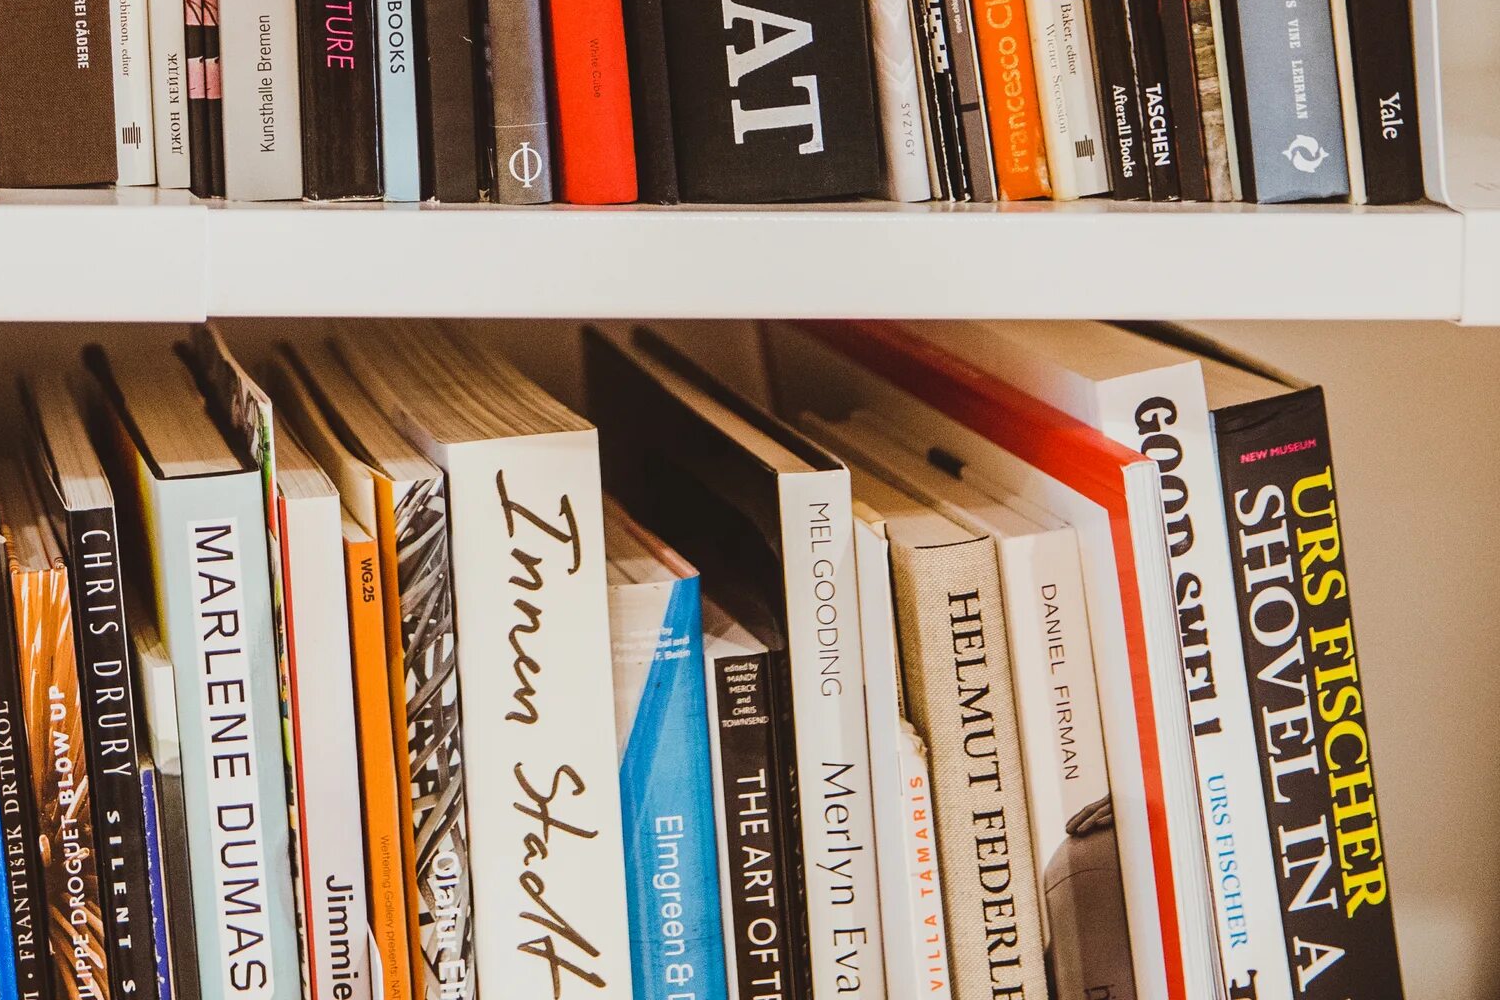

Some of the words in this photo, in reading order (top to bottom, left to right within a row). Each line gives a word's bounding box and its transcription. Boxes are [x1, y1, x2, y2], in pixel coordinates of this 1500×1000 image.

[387, 0, 405, 75] BOOKS
[1287, 19, 1300, 48] VINE
[1292, 60, 1308, 119] LEHRMAN
[997, 36, 1029, 174] Francesco
[1112, 84, 1130, 135] Afterall
[1118, 138, 1134, 177] Books
[1145, 83, 1169, 166] TASCHEN
[1378, 92, 1402, 139] Yale
[81, 530, 119, 635] CHRIS
[361, 558, 375, 603] WG.25
[809, 502, 832, 552] MEL
[1291, 467, 1346, 605] URS
[194, 525, 252, 778] MARLENE
[496, 470, 581, 724] Innen
[813, 559, 842, 696] GOODING
[93, 662, 132, 777] DRURY
[947, 590, 1002, 793] HELMUT
[1039, 584, 1066, 675] DANIEL
[1055, 685, 1080, 780] FIRMAN
[1234, 483, 1319, 802] SHOVEL
[1278, 816, 1338, 913] IN
[738, 769, 769, 835] THE
[1207, 773, 1228, 828] URS
[1308, 619, 1386, 918] FISCHER
[106, 811, 132, 950] SILENT
[513, 763, 606, 1000] Stadt
[741, 846, 775, 906] ART
[816, 763, 863, 905] Merlyn
[217, 804, 267, 991] DUMAS
[748, 918, 780, 963] OF
[1215, 835, 1249, 950] FISCHER
